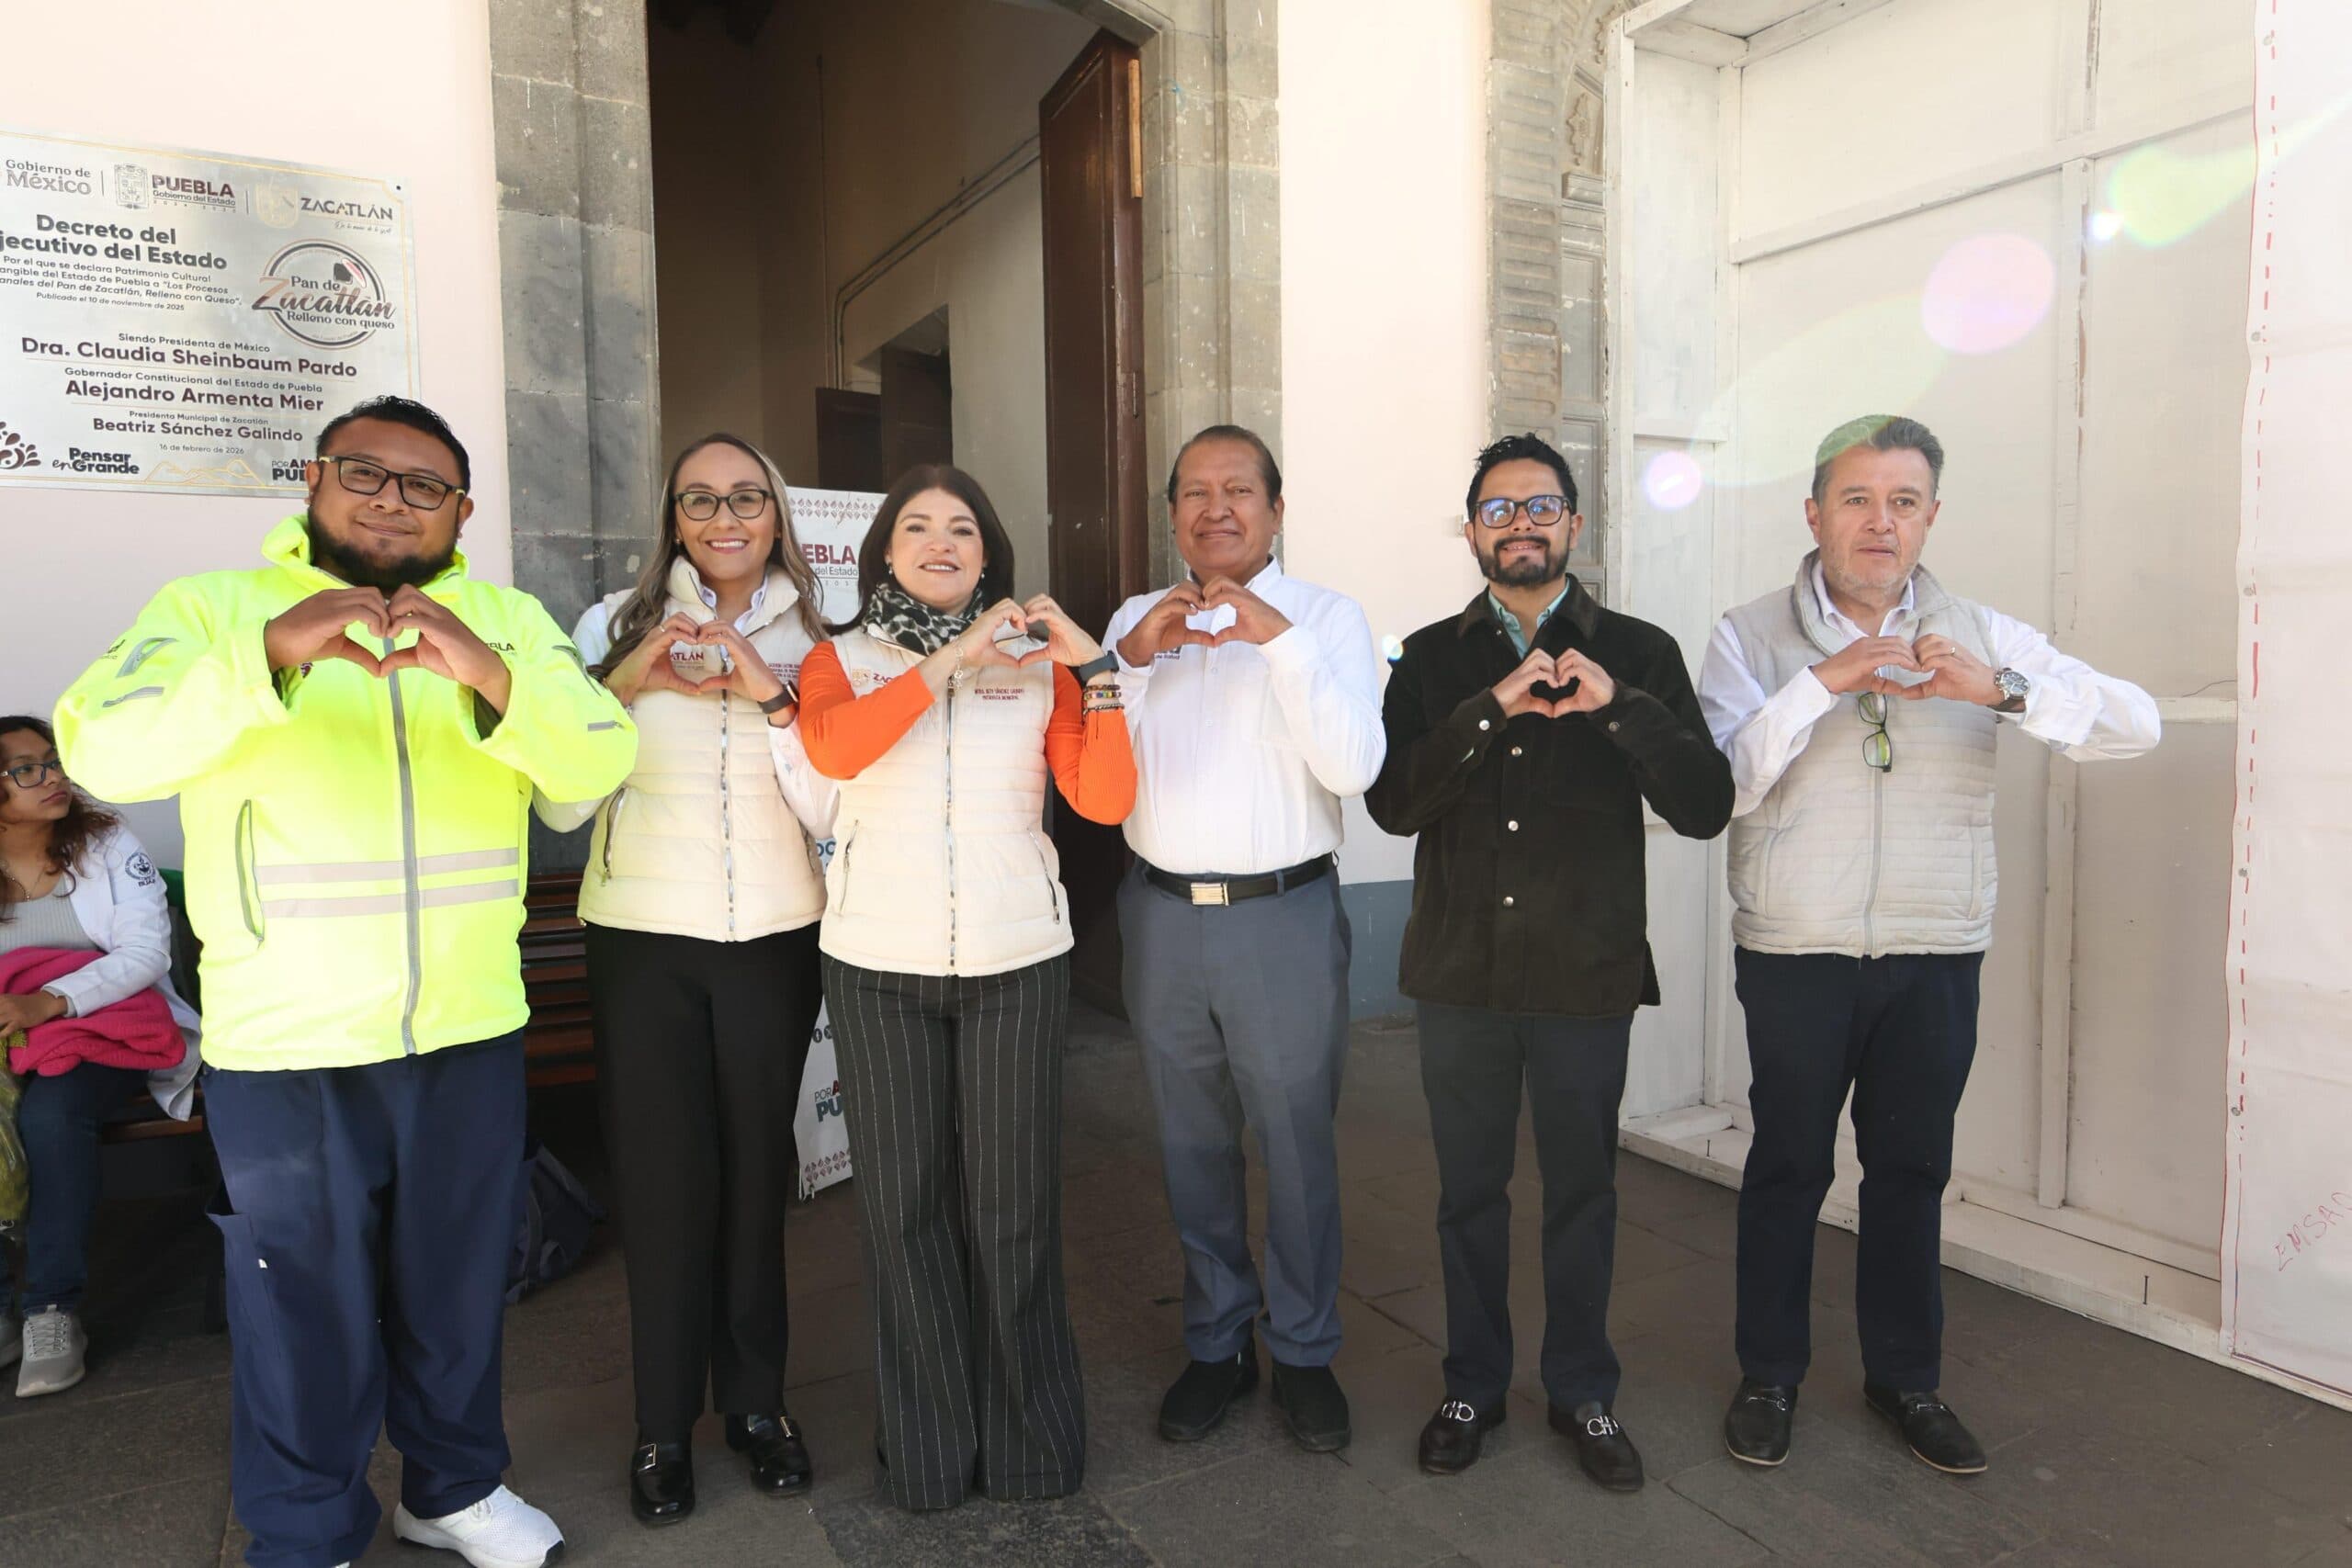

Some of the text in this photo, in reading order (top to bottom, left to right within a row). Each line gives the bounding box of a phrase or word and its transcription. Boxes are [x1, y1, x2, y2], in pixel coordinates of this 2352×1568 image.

[6, 159, 91, 178] Gobierno de
[6, 170, 92, 195] México
[153, 175, 234, 197] PUEBLA
[193, 195, 206, 203] del
[207, 197, 236, 206] Estado
[300, 197, 393, 220] ZACATLÁN
[37, 214, 176, 245] Decreto del
[104, 243, 141, 261] del
[148, 246, 227, 269] Estado
[4, 255, 20, 265] Por
[36, 260, 56, 268] que
[74, 262, 112, 274] declara
[115, 266, 169, 278] Patrimonio
[172, 272, 211, 283] Cultural
[37, 279, 54, 288] del
[57, 281, 76, 290] Pan
[79, 283, 92, 292] de
[96, 285, 142, 297] Zacatlán,
[145, 289, 182, 300] Relleno
[42, 269, 58, 278] del
[62, 271, 96, 282] Estado
[115, 276, 151, 288] Puebla
[186, 283, 229, 294] Procesos
[291, 276, 341, 291] Pan de
[37, 292, 77, 302] Publicado
[111, 299, 152, 308] noviembre
[252, 277, 397, 320] Zacatlán
[288, 311, 395, 330] Relleno con queso
[119, 333, 270, 353] Siendo Presidenta de México
[22, 337, 357, 377] Dra. Claudia Sheinbaum Pardo
[64, 367, 132, 379] Gobernador
[136, 372, 212, 385] Constitucional
[215, 378, 232, 386] del
[235, 378, 269, 389] Estado
[288, 382, 322, 392] Puebla
[65, 380, 323, 412] Alejandro Armenta Mier
[130, 411, 175, 420] Presidenta
[177, 413, 218, 423] Municipal
[94, 418, 303, 442] Beatriz Sánchez Galindo
[69, 447, 132, 463] Pensar
[182, 445, 211, 453] febrero
[52, 459, 140, 475] en Grande
[271, 459, 289, 468] POR
[815, 566, 858, 576] del Estado
[485, 642, 514, 651] BLA
[815, 1088, 831, 1102] POR
